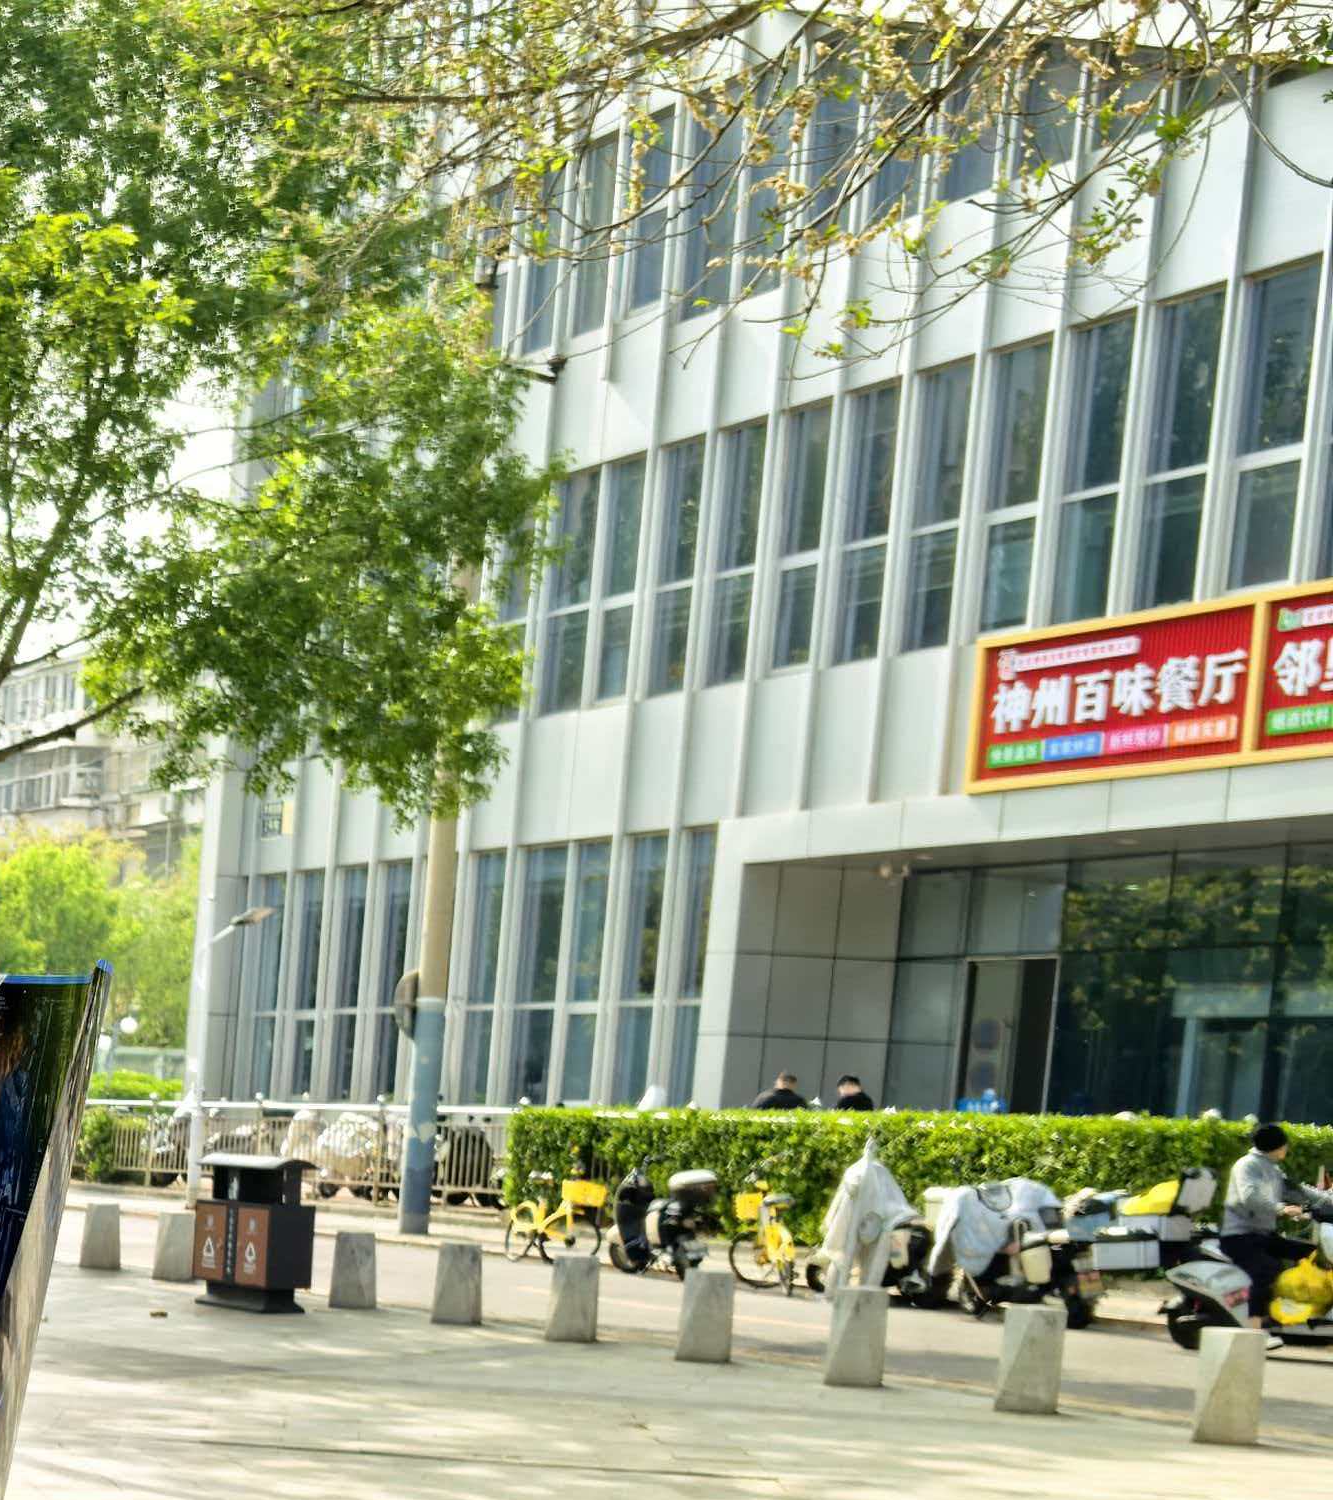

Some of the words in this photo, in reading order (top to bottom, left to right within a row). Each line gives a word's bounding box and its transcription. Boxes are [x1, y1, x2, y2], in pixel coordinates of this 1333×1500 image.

[991, 648, 1247, 734] 神州百味餐厅
[1273, 639, 1333, 698] 邻
